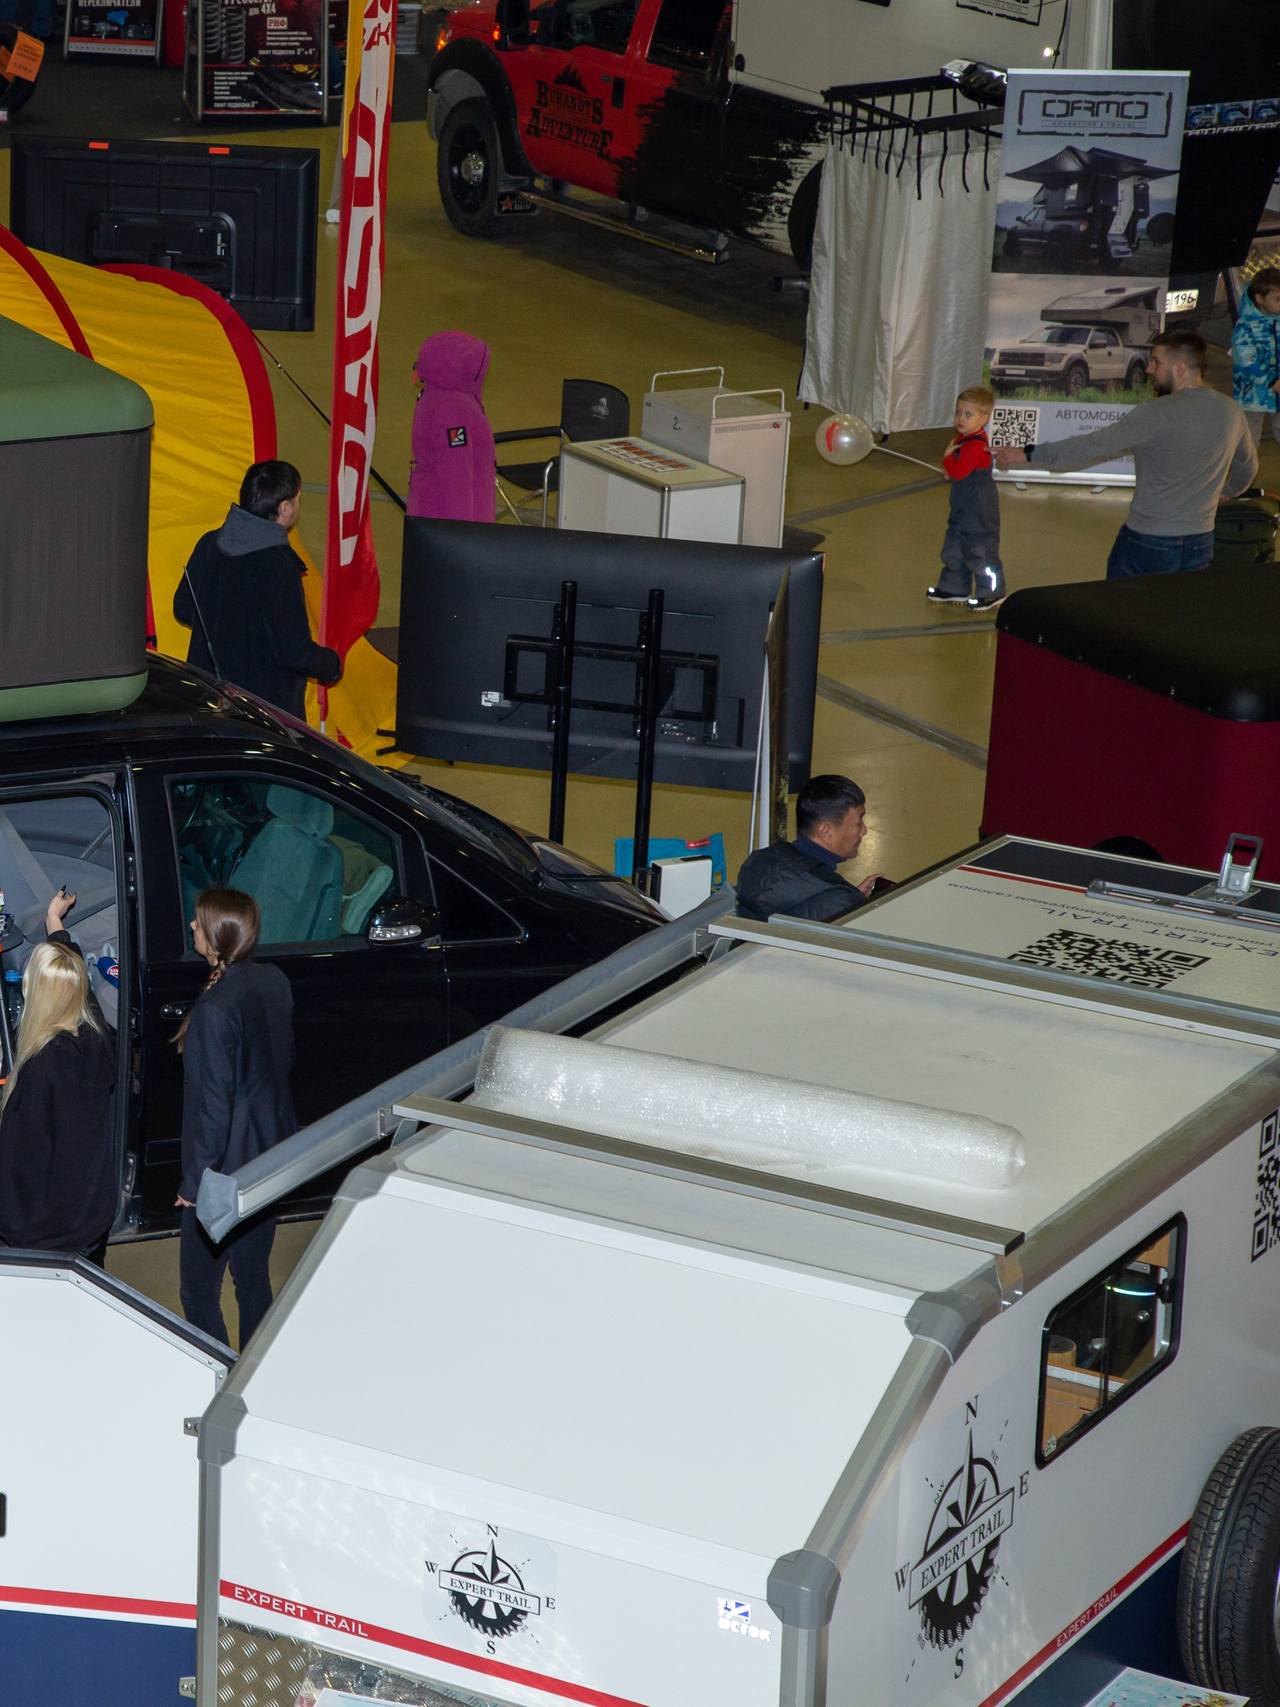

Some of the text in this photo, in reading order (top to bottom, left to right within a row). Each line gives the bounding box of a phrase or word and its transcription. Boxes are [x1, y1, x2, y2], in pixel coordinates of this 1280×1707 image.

[525, 106, 613, 160] ADVENTURE
[1174, 292, 1196, 305] 196
[1040, 907, 1279, 957] EXPERT TRAIL
[964, 1394, 979, 1426] N
[1018, 1470, 1030, 1499] E
[486, 1523, 499, 1538] N
[920, 1509, 1005, 1591] EXPERT TRAIL
[425, 1560, 439, 1574] W
[894, 1562, 911, 1593] W
[450, 1577, 531, 1609] EXPERT TRAIL
[545, 1596, 556, 1610] E
[234, 1586, 369, 1637] EXPERT TRAIL
[1057, 1588, 1119, 1648] EXPERT TRAIL
[486, 1640, 496, 1655] S
[953, 1647, 965, 1680] S
